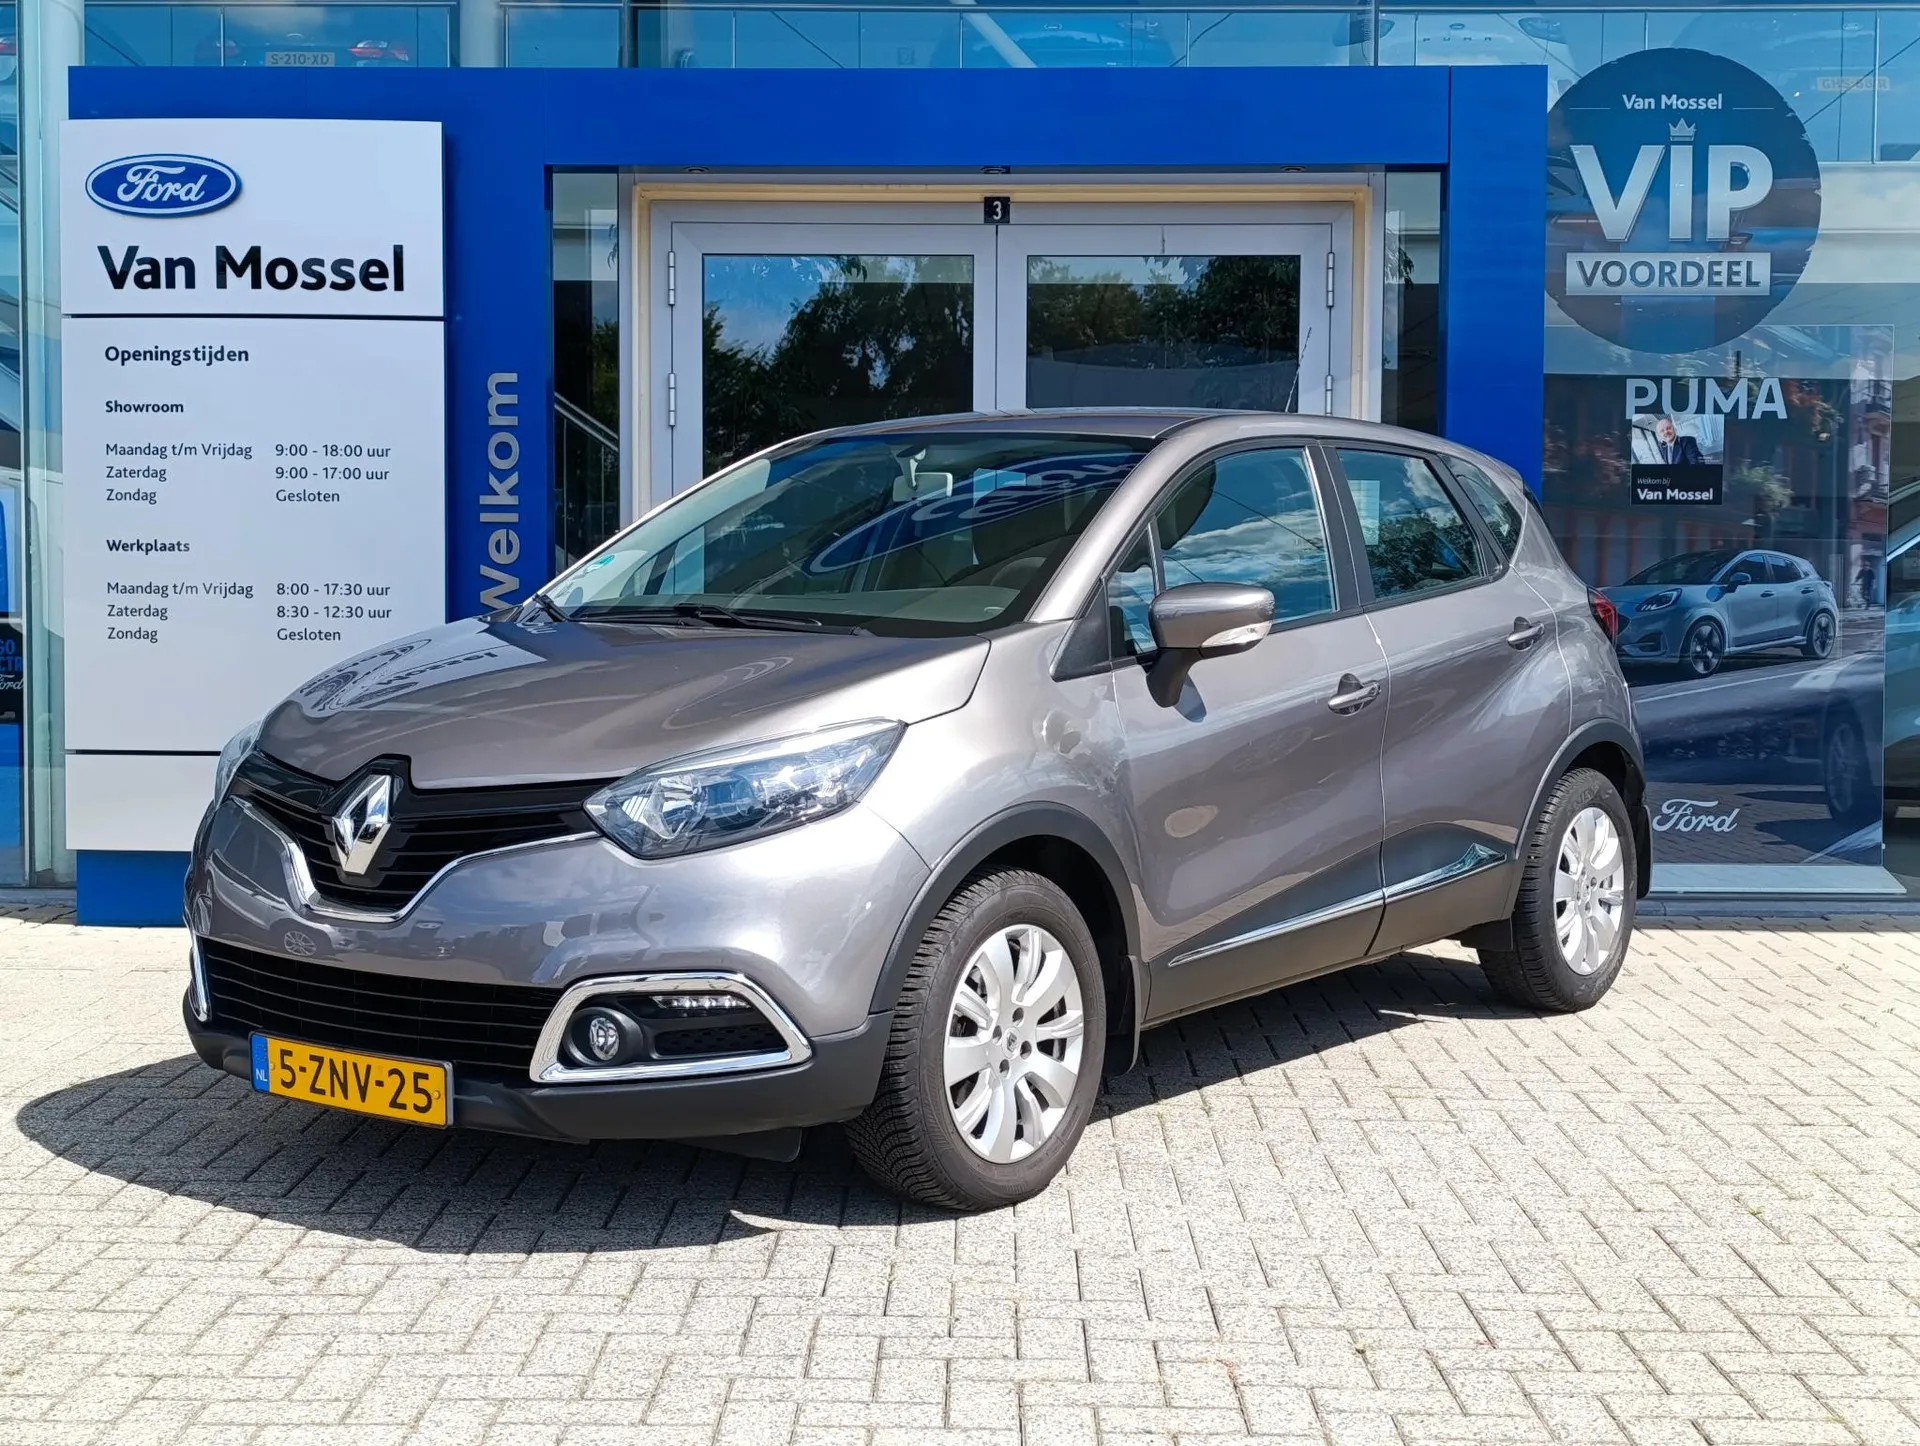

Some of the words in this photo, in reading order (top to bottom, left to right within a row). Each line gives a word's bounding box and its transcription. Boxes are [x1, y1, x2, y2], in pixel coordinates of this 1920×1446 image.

[1622, 93, 1656, 110] Van
[1660, 93, 1723, 110] Mossel
[116, 164, 208, 203] Ford
[1569, 144, 1774, 242] VIP
[992, 200, 1002, 220] 3
[97, 244, 196, 291] Van
[215, 244, 405, 292] Mossel
[1576, 260, 1762, 288] VOORDEEL
[104, 345, 250, 367] Openingstijden
[105, 399, 185, 414] Showroom
[1625, 377, 1789, 420] PUMA
[105, 442, 168, 460] Maandag
[171, 442, 198, 457] t/m
[201, 442, 253, 461] Vrijdag
[275, 443, 309, 457] 9:00
[323, 443, 363, 458] 18:00
[366, 447, 392, 458] uur
[105, 464, 168, 482] Zaterdag
[275, 466, 309, 480] 9:00
[323, 466, 362, 481] 17:00
[365, 470, 390, 481] uur
[106, 487, 158, 505] Zondag
[275, 488, 340, 503] Gesloten
[479, 372, 520, 613] Welkom
[1637, 489, 1662, 501] Van
[1666, 488, 1714, 501] Mossel
[106, 538, 191, 556] Werkplaats
[106, 581, 168, 598] Maandag
[172, 581, 199, 596] t/m
[202, 581, 254, 600] Vrijdag
[276, 582, 310, 596] 8:00
[324, 582, 363, 597] 17:30
[366, 586, 391, 597] uur
[106, 603, 169, 621] Zaterdag
[276, 605, 310, 619] 8:30
[324, 605, 364, 619] 12:30
[367, 608, 393, 619] uur
[107, 626, 159, 644] Zondag
[276, 627, 342, 642] Gesloten
[1652, 798, 1740, 832] Ford
[255, 1067, 268, 1082] NL
[279, 1048, 433, 1114] 5-ZNV-25
